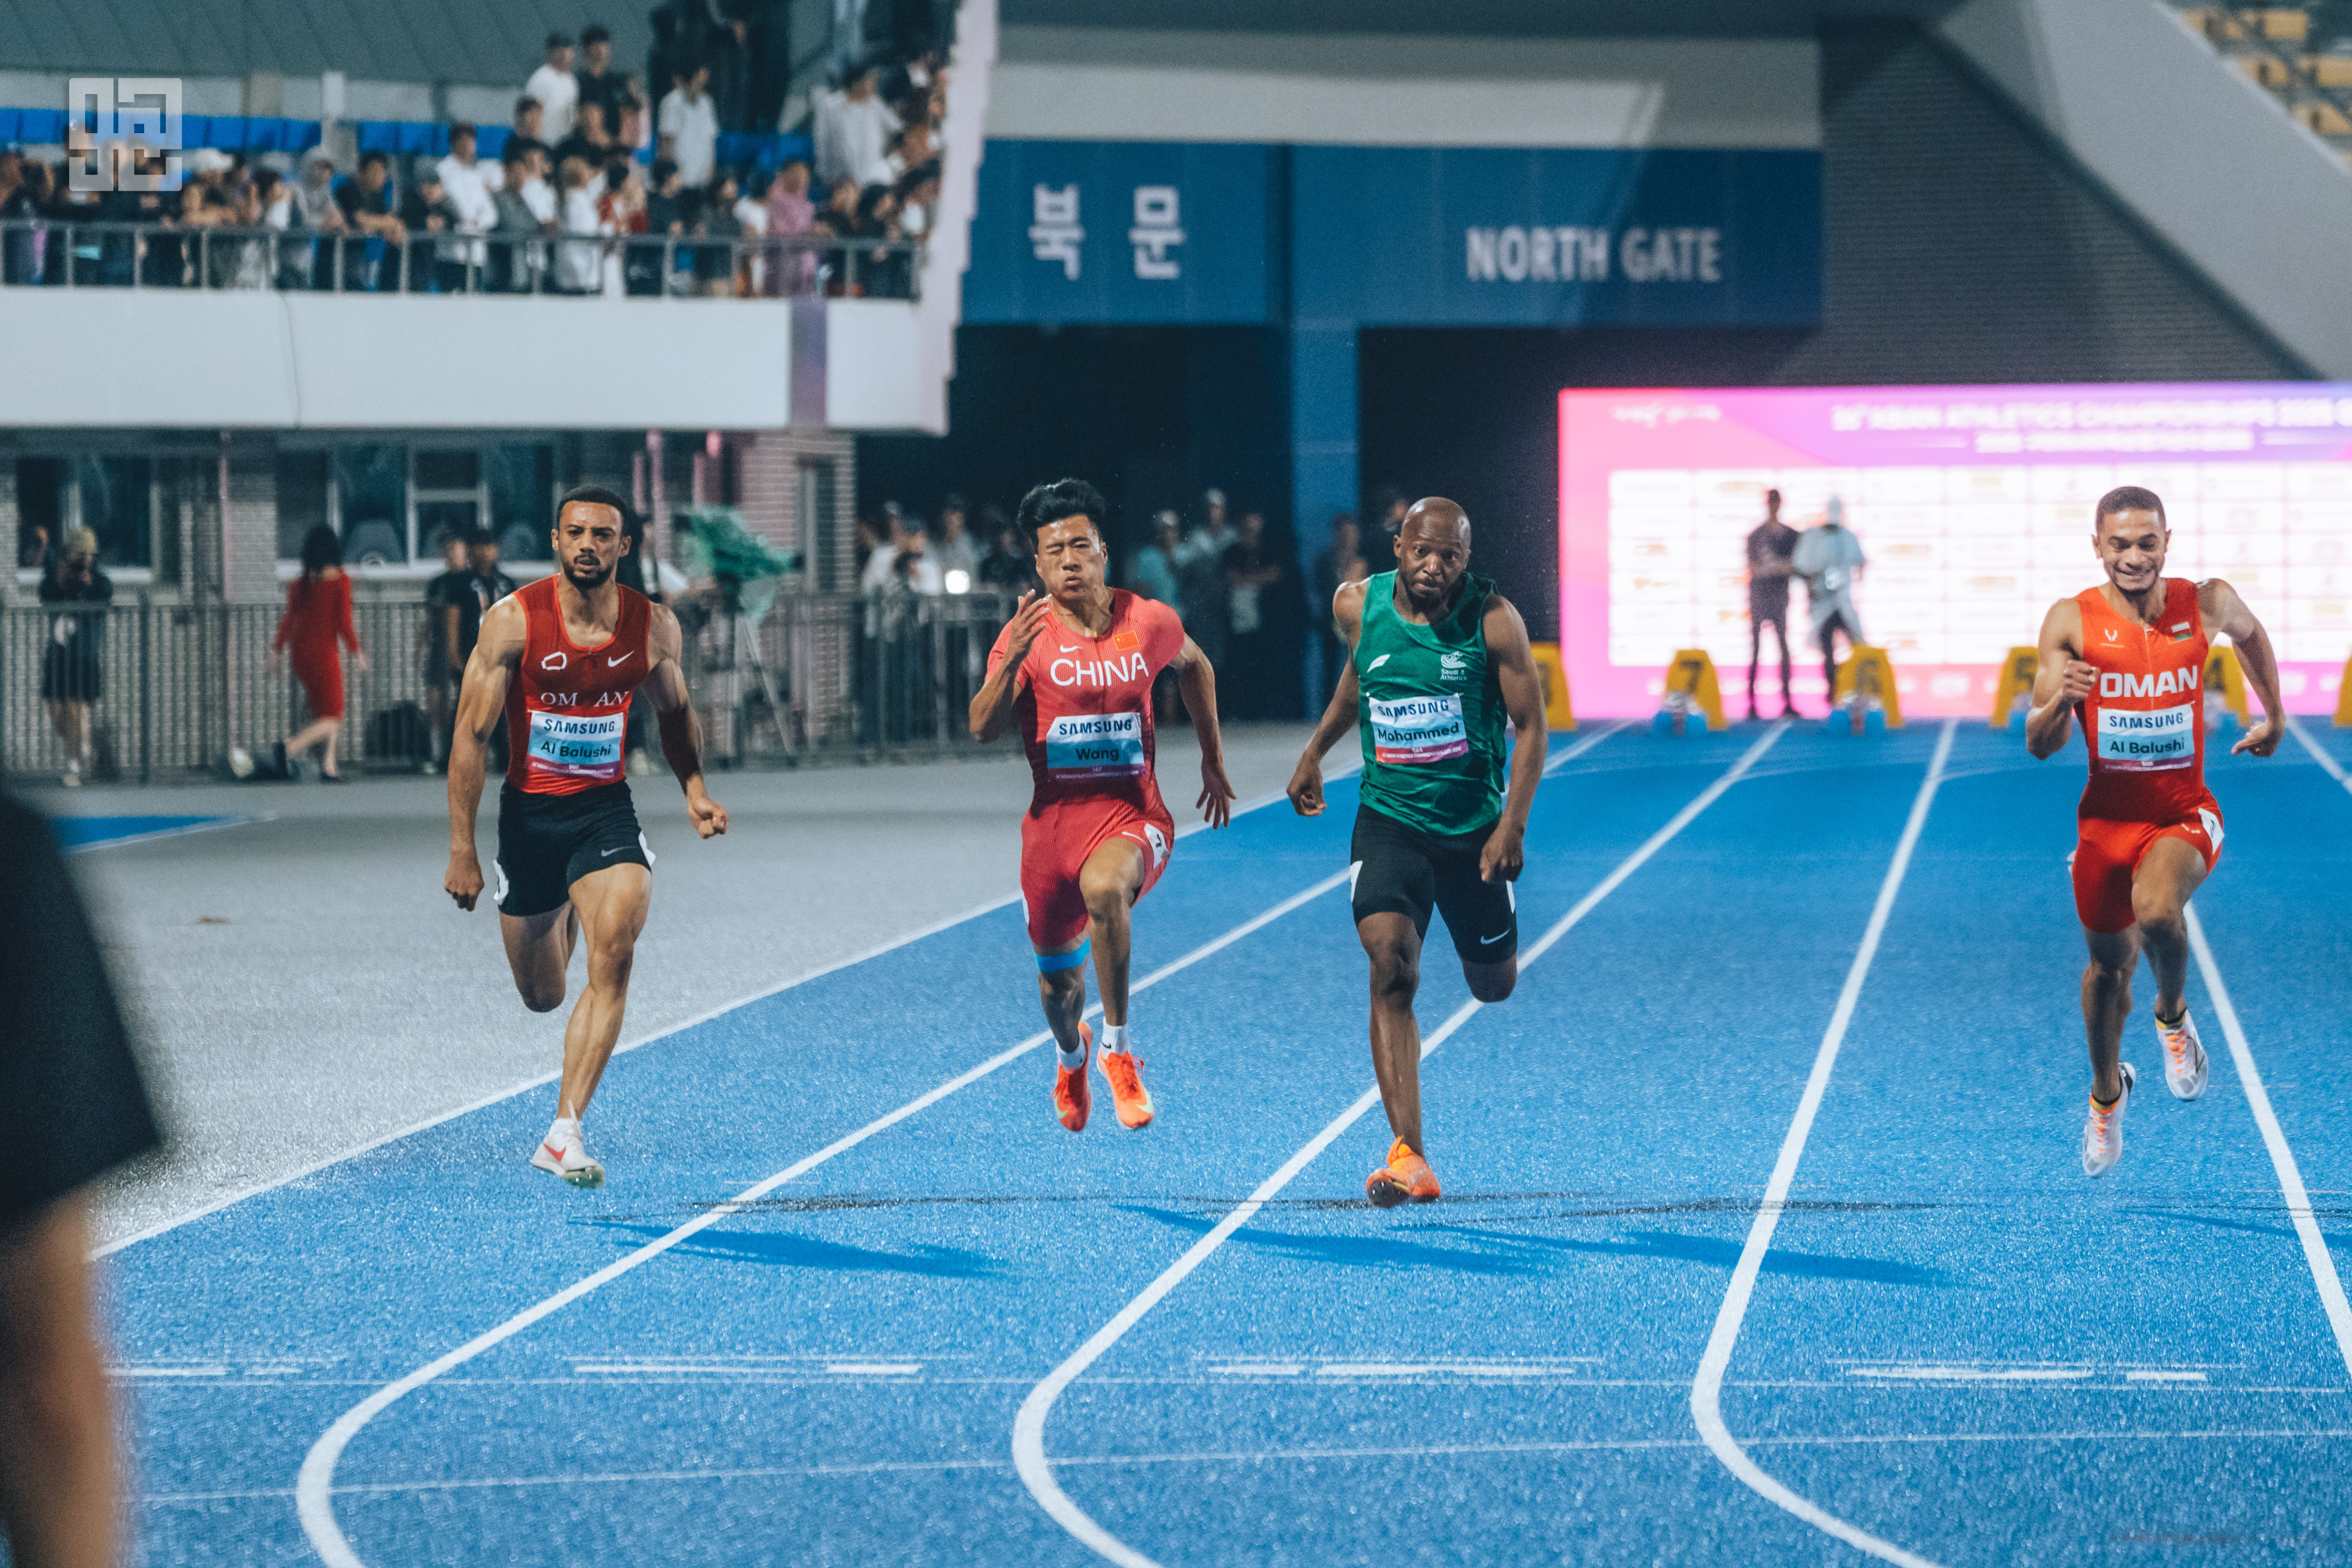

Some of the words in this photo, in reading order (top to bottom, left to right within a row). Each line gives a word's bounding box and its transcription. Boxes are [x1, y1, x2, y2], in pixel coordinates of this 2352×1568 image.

[1466, 226, 1609, 282] NORTH
[1621, 226, 1721, 282] GATE
[1051, 652, 1149, 686] CHINA
[1680, 659, 1704, 693] 7
[2100, 666, 2198, 698] OMAN
[1378, 700, 1449, 717] SAMSUNG
[544, 718, 615, 734] SAMSUNG
[1059, 719, 1132, 736] SAMSUNG
[2109, 713, 2184, 729] SAMSUNG
[1378, 722, 1459, 741] Mohammed
[541, 741, 556, 754] Al
[559, 743, 611, 758] Balushi
[2110, 741, 2125, 753] Al
[2129, 738, 2185, 754] Balushi
[1076, 748, 1119, 762] Wang
